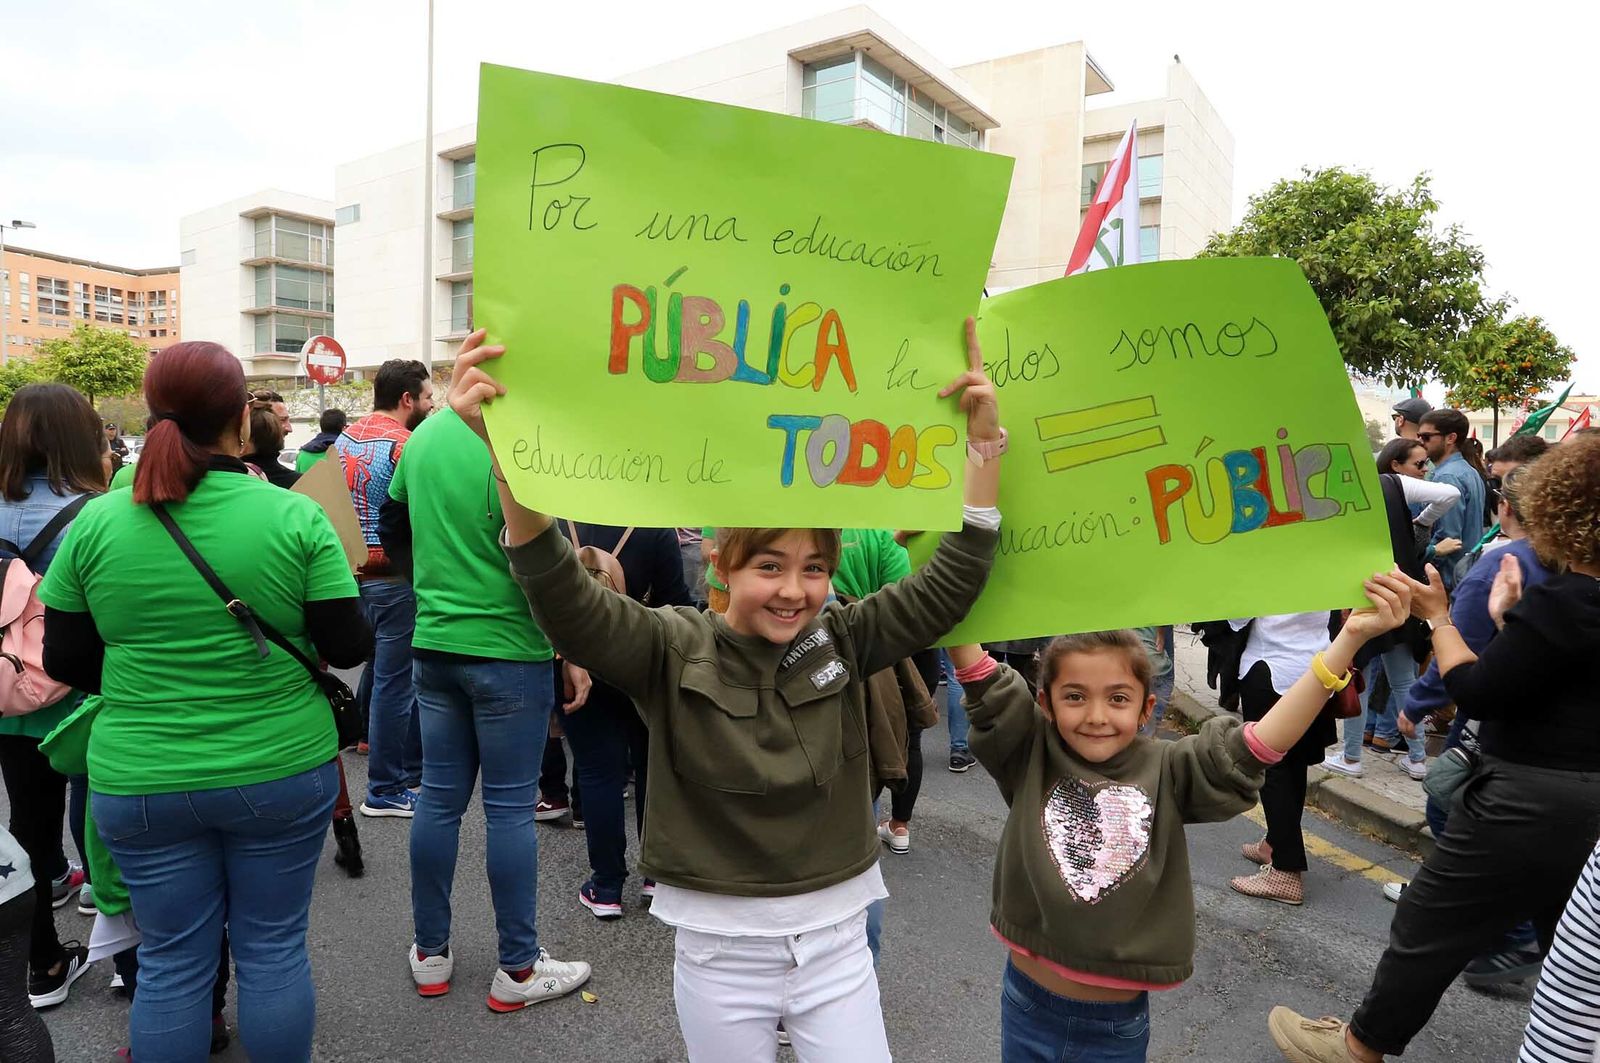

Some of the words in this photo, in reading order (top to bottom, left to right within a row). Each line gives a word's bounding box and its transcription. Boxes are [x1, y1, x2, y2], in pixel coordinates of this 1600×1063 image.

[529, 143, 598, 231] Por
[635, 211, 748, 242] una
[772, 215, 944, 277] educación
[886, 338, 938, 390] la
[977, 317, 1060, 388] odos
[1109, 316, 1279, 373] somos
[686, 437, 733, 484] de
[766, 413, 958, 490] TODOS
[995, 496, 1142, 556] ucación:
[1144, 427, 1373, 545] PÚBLICA
[816, 661, 847, 687] STAR
